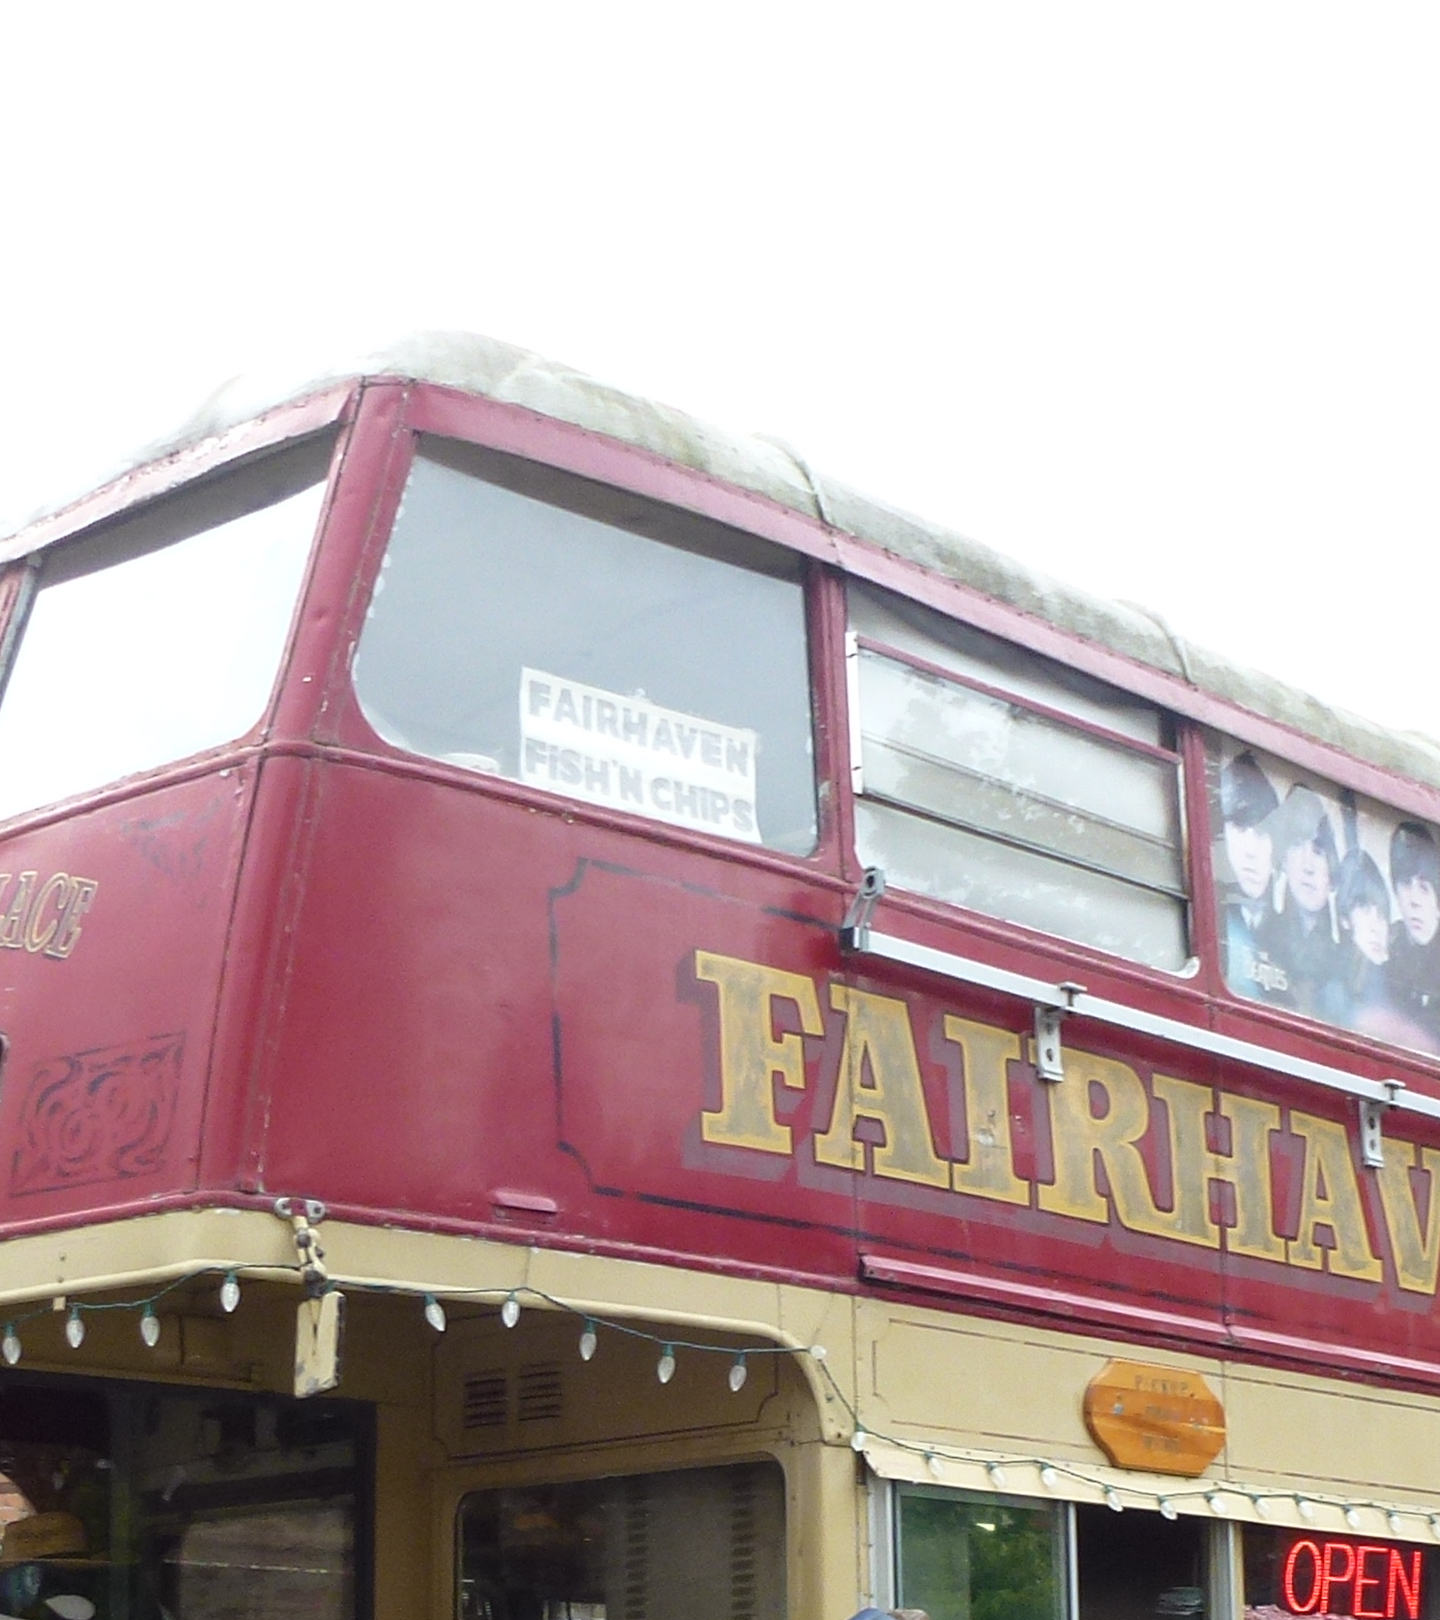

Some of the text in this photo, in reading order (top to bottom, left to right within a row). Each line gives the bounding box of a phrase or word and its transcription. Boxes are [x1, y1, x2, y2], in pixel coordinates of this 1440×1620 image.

[527, 679, 750, 777] FAIRHAVEN
[649, 776, 754, 832] CHIPS
[1284, 1540, 1422, 1620] OPEN
